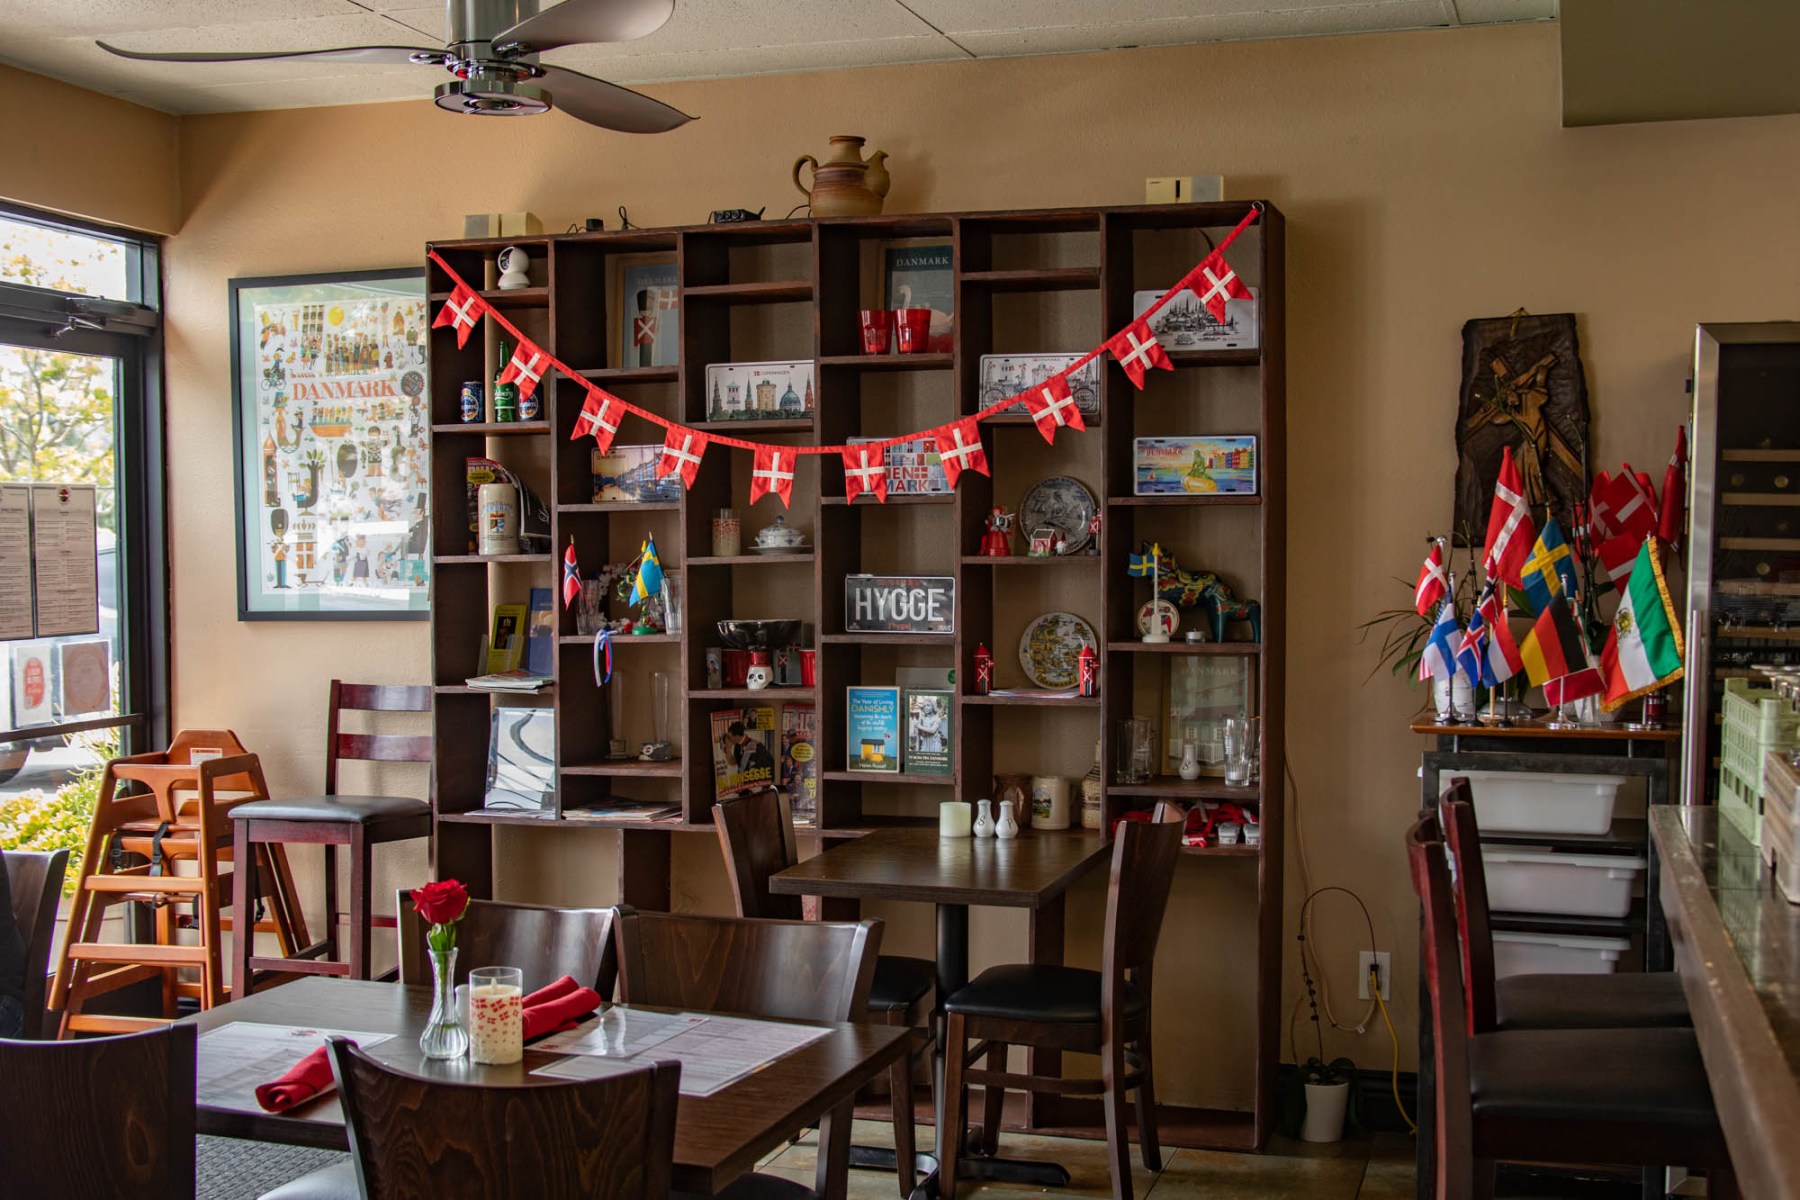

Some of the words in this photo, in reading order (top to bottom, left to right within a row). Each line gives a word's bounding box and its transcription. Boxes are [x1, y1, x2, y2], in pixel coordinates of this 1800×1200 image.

[896, 256, 950, 266] DANMARK
[292, 380, 398, 400] DANMARK
[855, 587, 945, 621] HYGGE
[851, 705, 894, 713] DANISHLY
[978, 815, 986, 826] S
